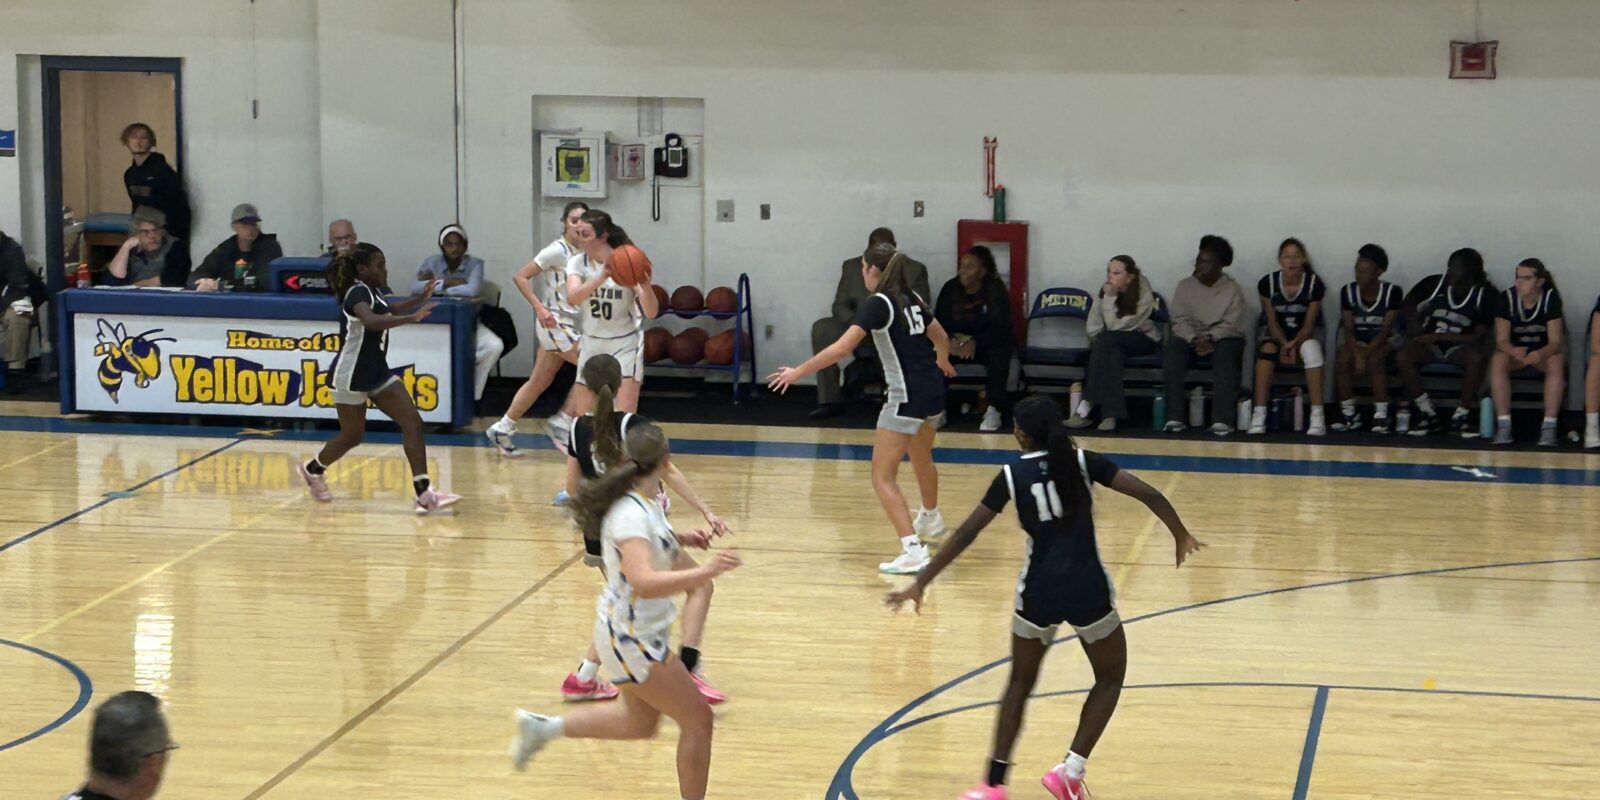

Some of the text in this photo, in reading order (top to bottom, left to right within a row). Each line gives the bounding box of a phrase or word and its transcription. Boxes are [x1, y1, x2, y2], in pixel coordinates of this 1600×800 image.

[590, 299, 613, 320] 20
[903, 305, 925, 335] 15
[227, 330, 295, 351] Home
[298, 332, 322, 351] of
[170, 355, 439, 411] Yellow Jats
